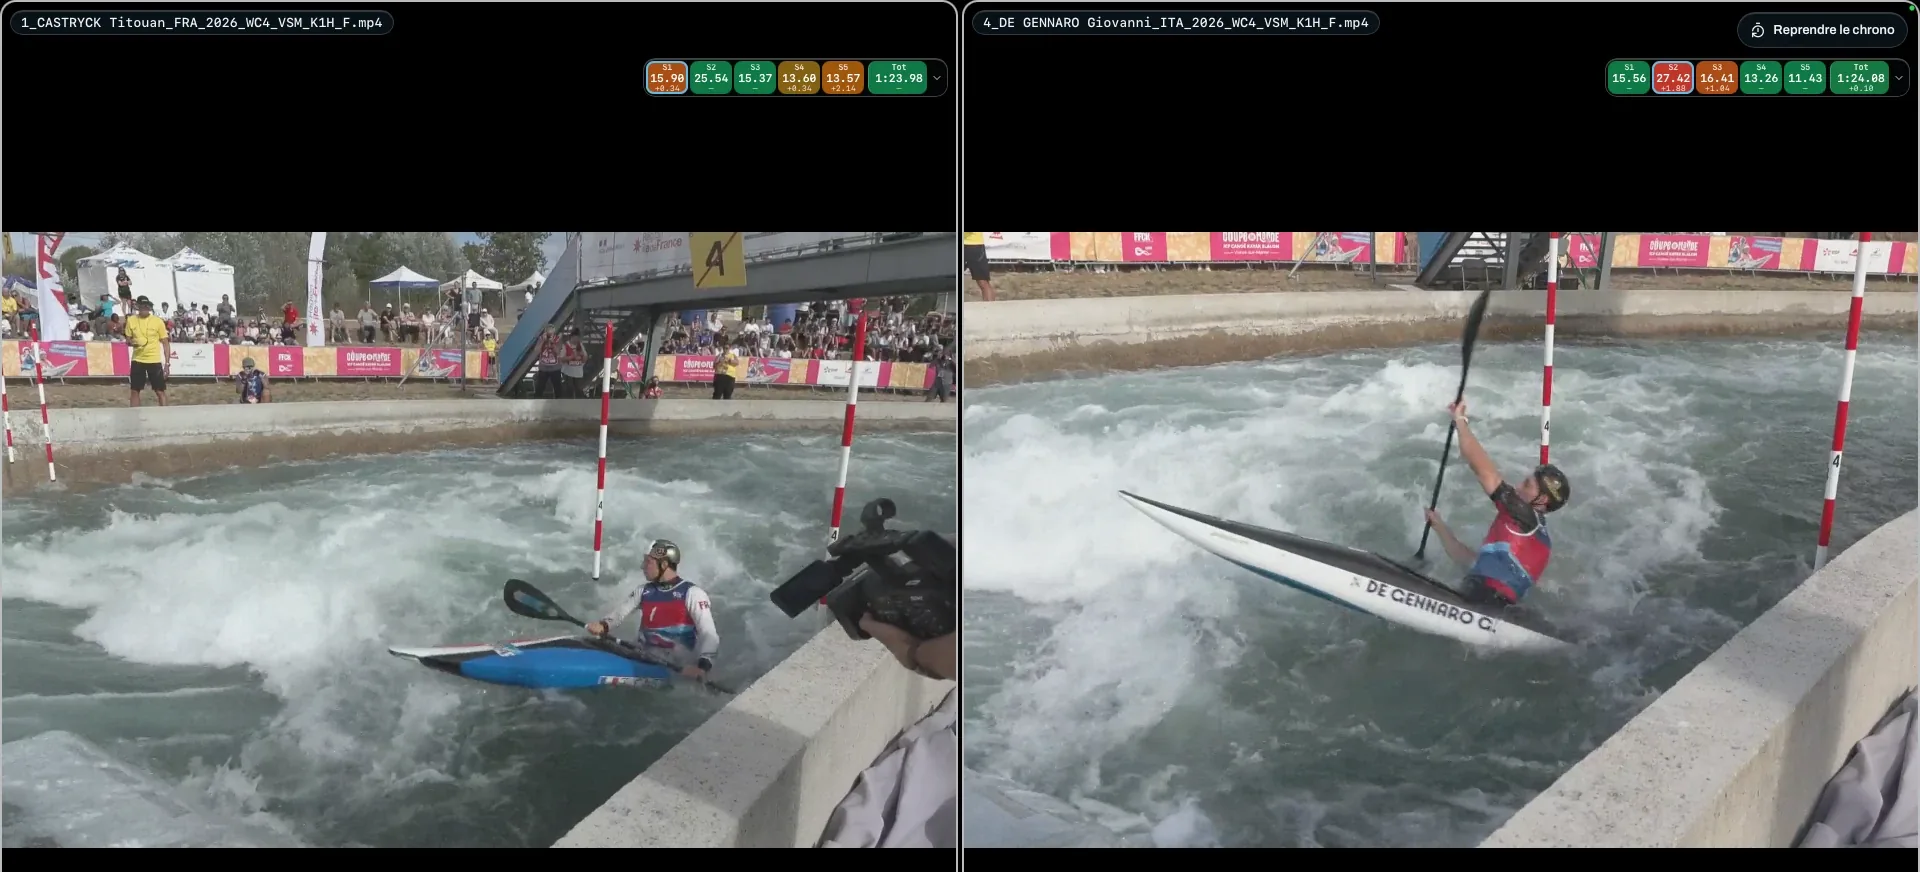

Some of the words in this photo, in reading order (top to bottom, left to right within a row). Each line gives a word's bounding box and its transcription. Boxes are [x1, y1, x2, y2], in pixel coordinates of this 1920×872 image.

[1832, 454, 1840, 468] 4
[831, 530, 838, 541] 4
[1366, 580, 1387, 597] DE
[1391, 588, 1474, 624] GENNARO
